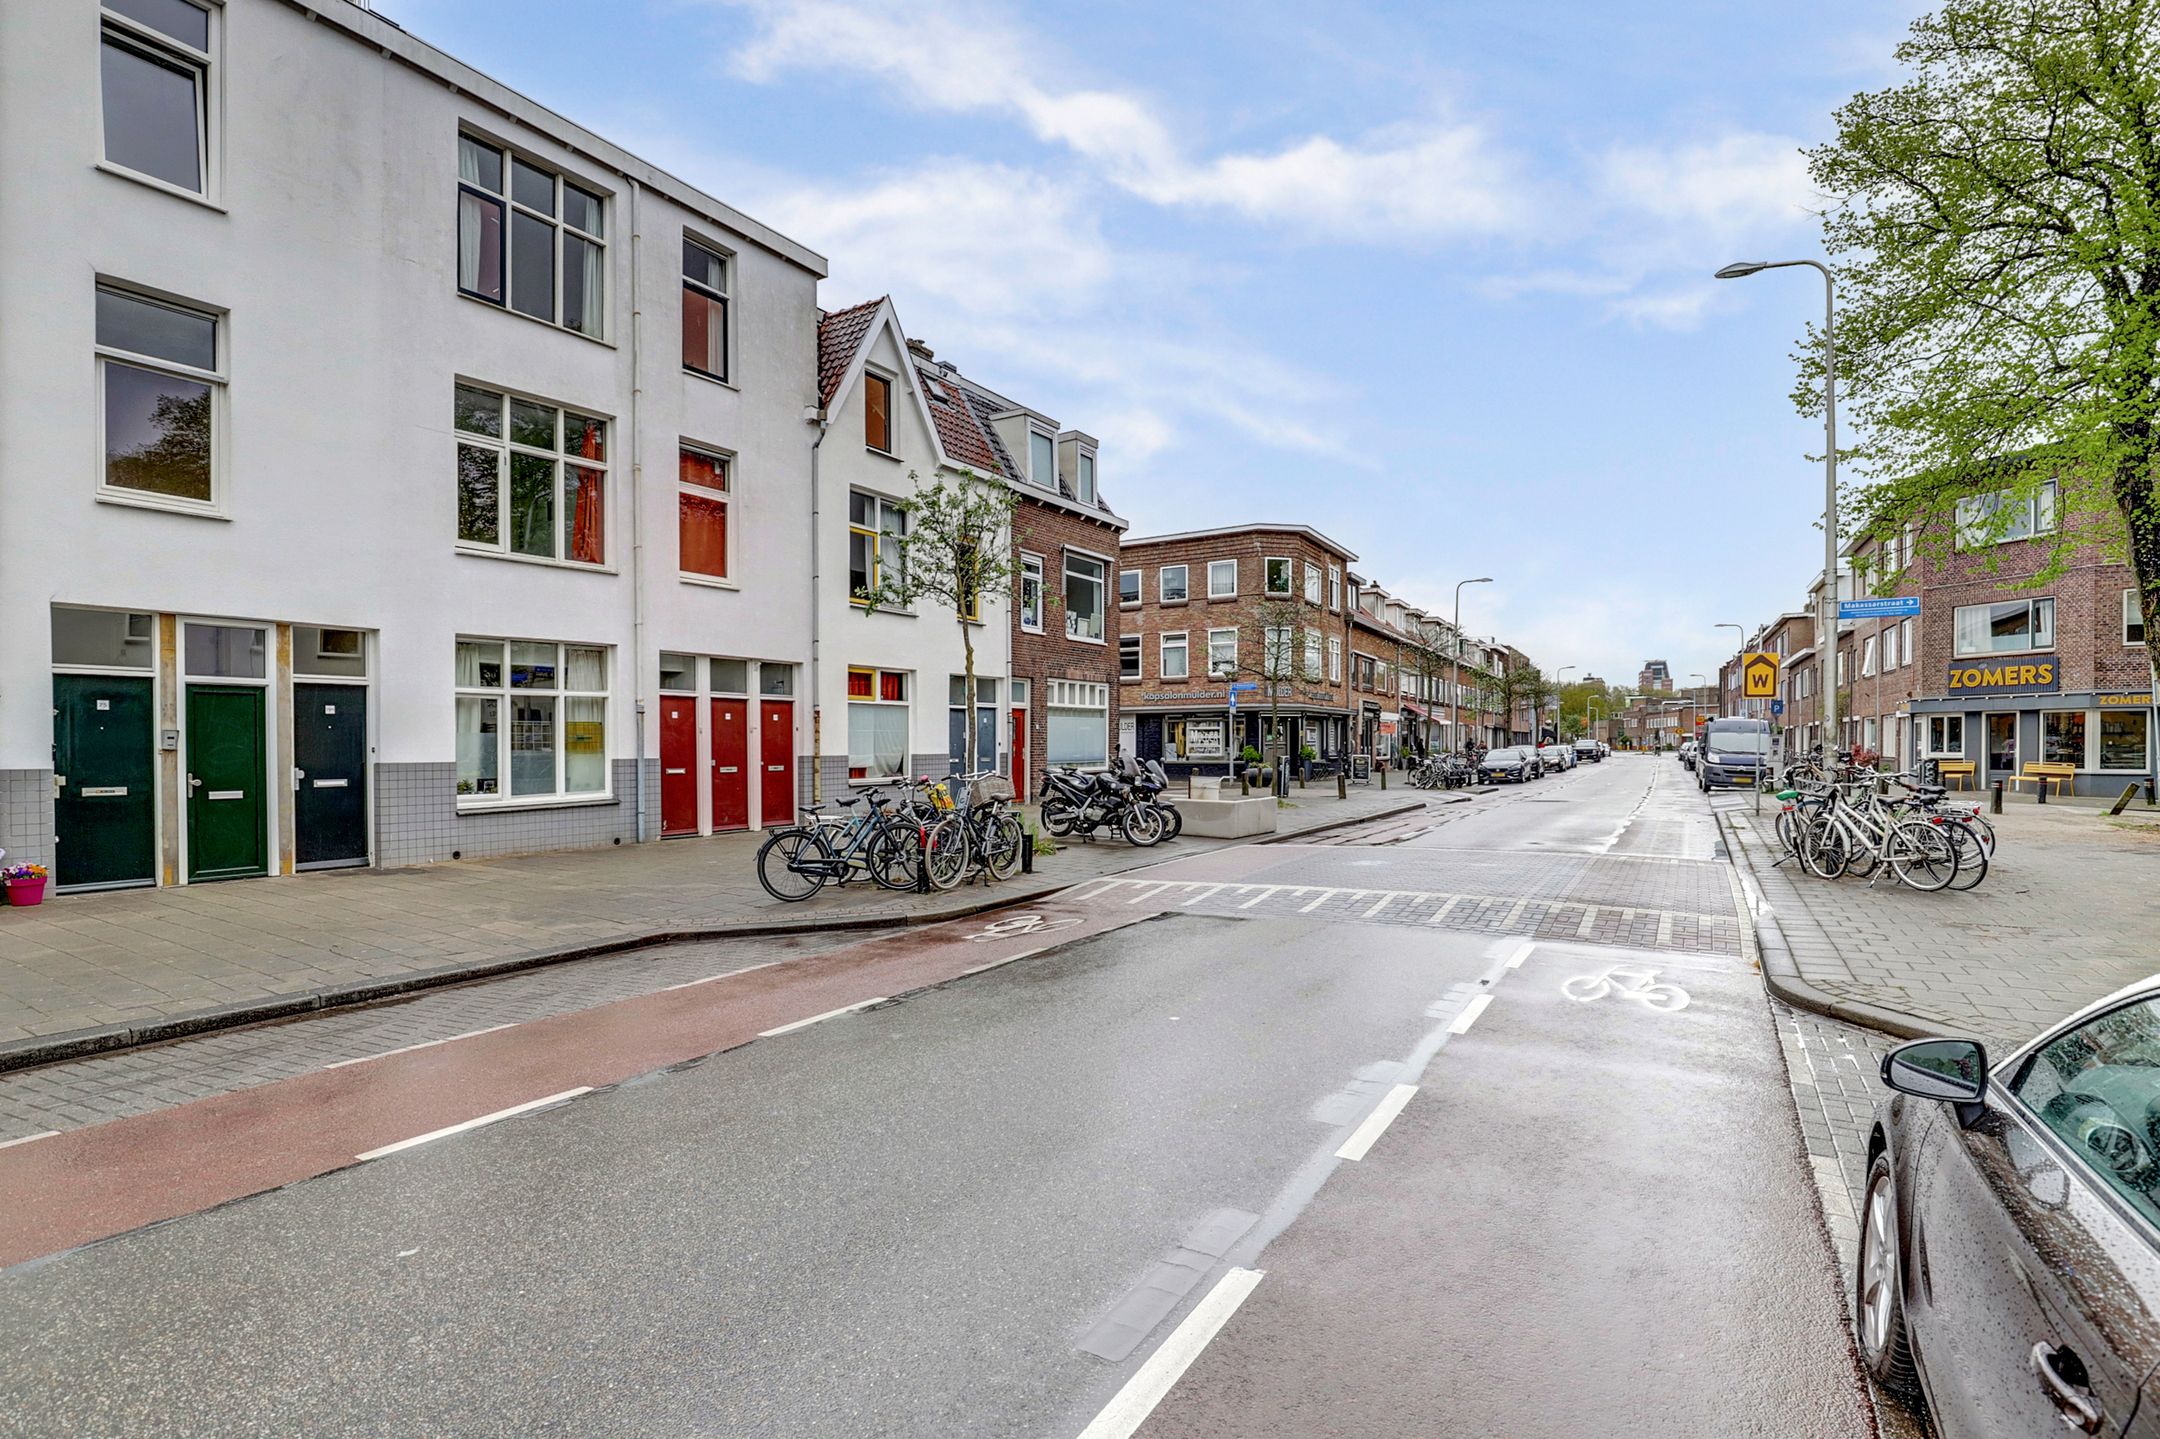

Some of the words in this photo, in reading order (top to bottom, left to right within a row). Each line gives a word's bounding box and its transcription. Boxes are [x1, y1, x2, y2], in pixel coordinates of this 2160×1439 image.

[1752, 674, 1769, 688] W
[1949, 663, 2054, 688] ZOMERS
[1143, 689, 1226, 702] kapsalonmulder.nl
